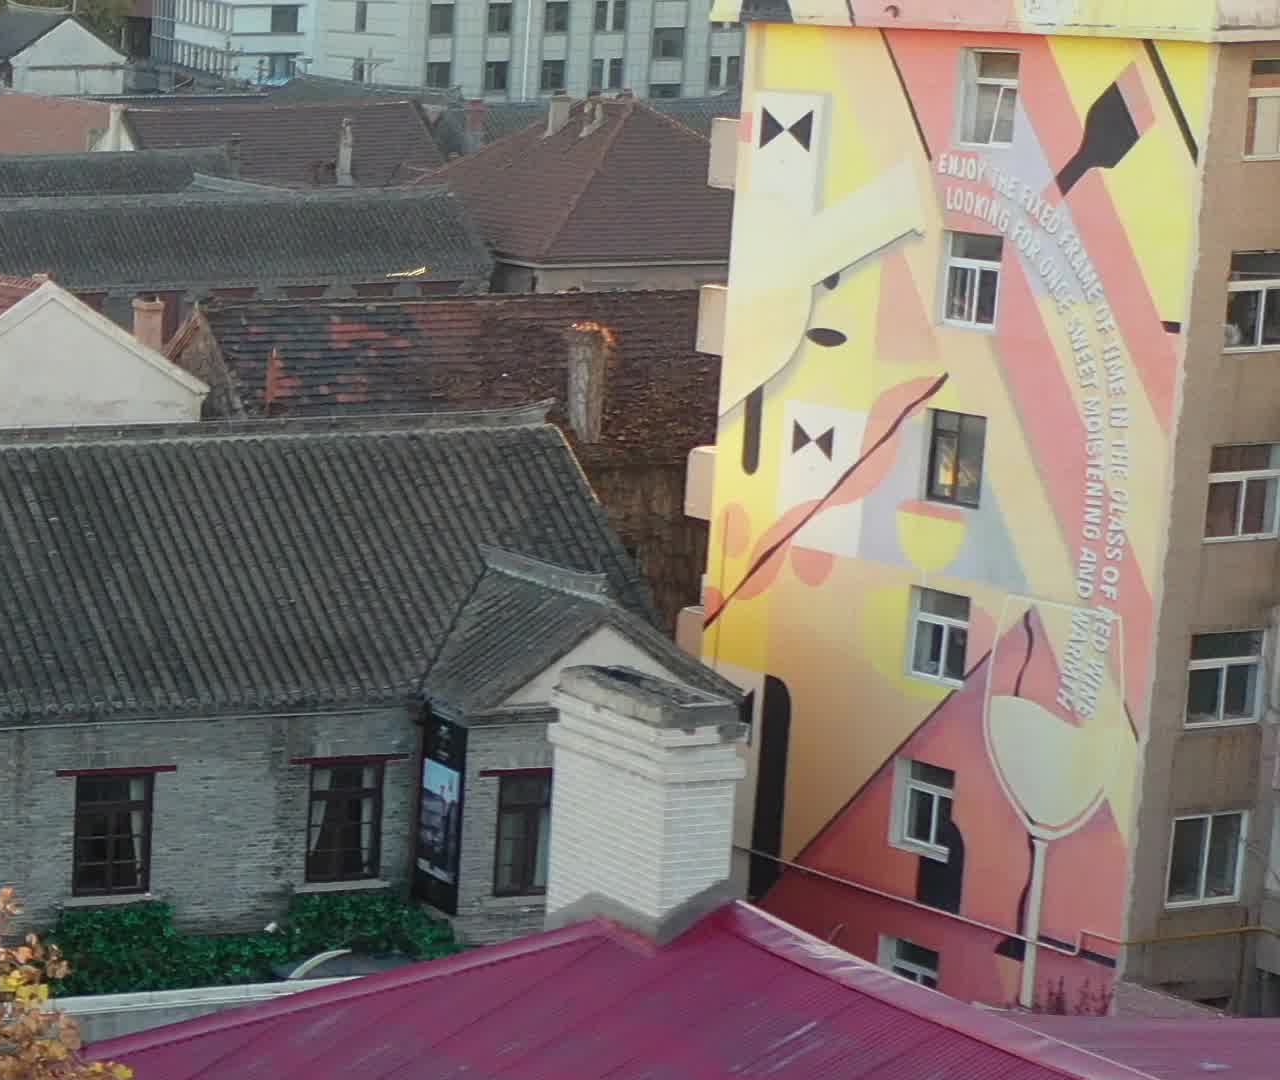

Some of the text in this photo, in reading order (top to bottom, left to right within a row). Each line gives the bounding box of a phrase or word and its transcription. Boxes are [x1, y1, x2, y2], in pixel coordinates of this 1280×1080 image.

[938, 153, 987, 182] ENJOY
[991, 166, 1020, 199] THE
[944, 186, 1010, 233] LOOKING
[1020, 184, 1061, 235] FIXED
[1011, 222, 1041, 261] FOR
[1110, 402, 1129, 429] IN
[1080, 398, 1105, 540] MOISTENING
[1111, 440, 1129, 481] THE
[1104, 488, 1129, 561] GLASS
[1078, 546, 1097, 599] AND
[1099, 566, 1121, 601] OF
